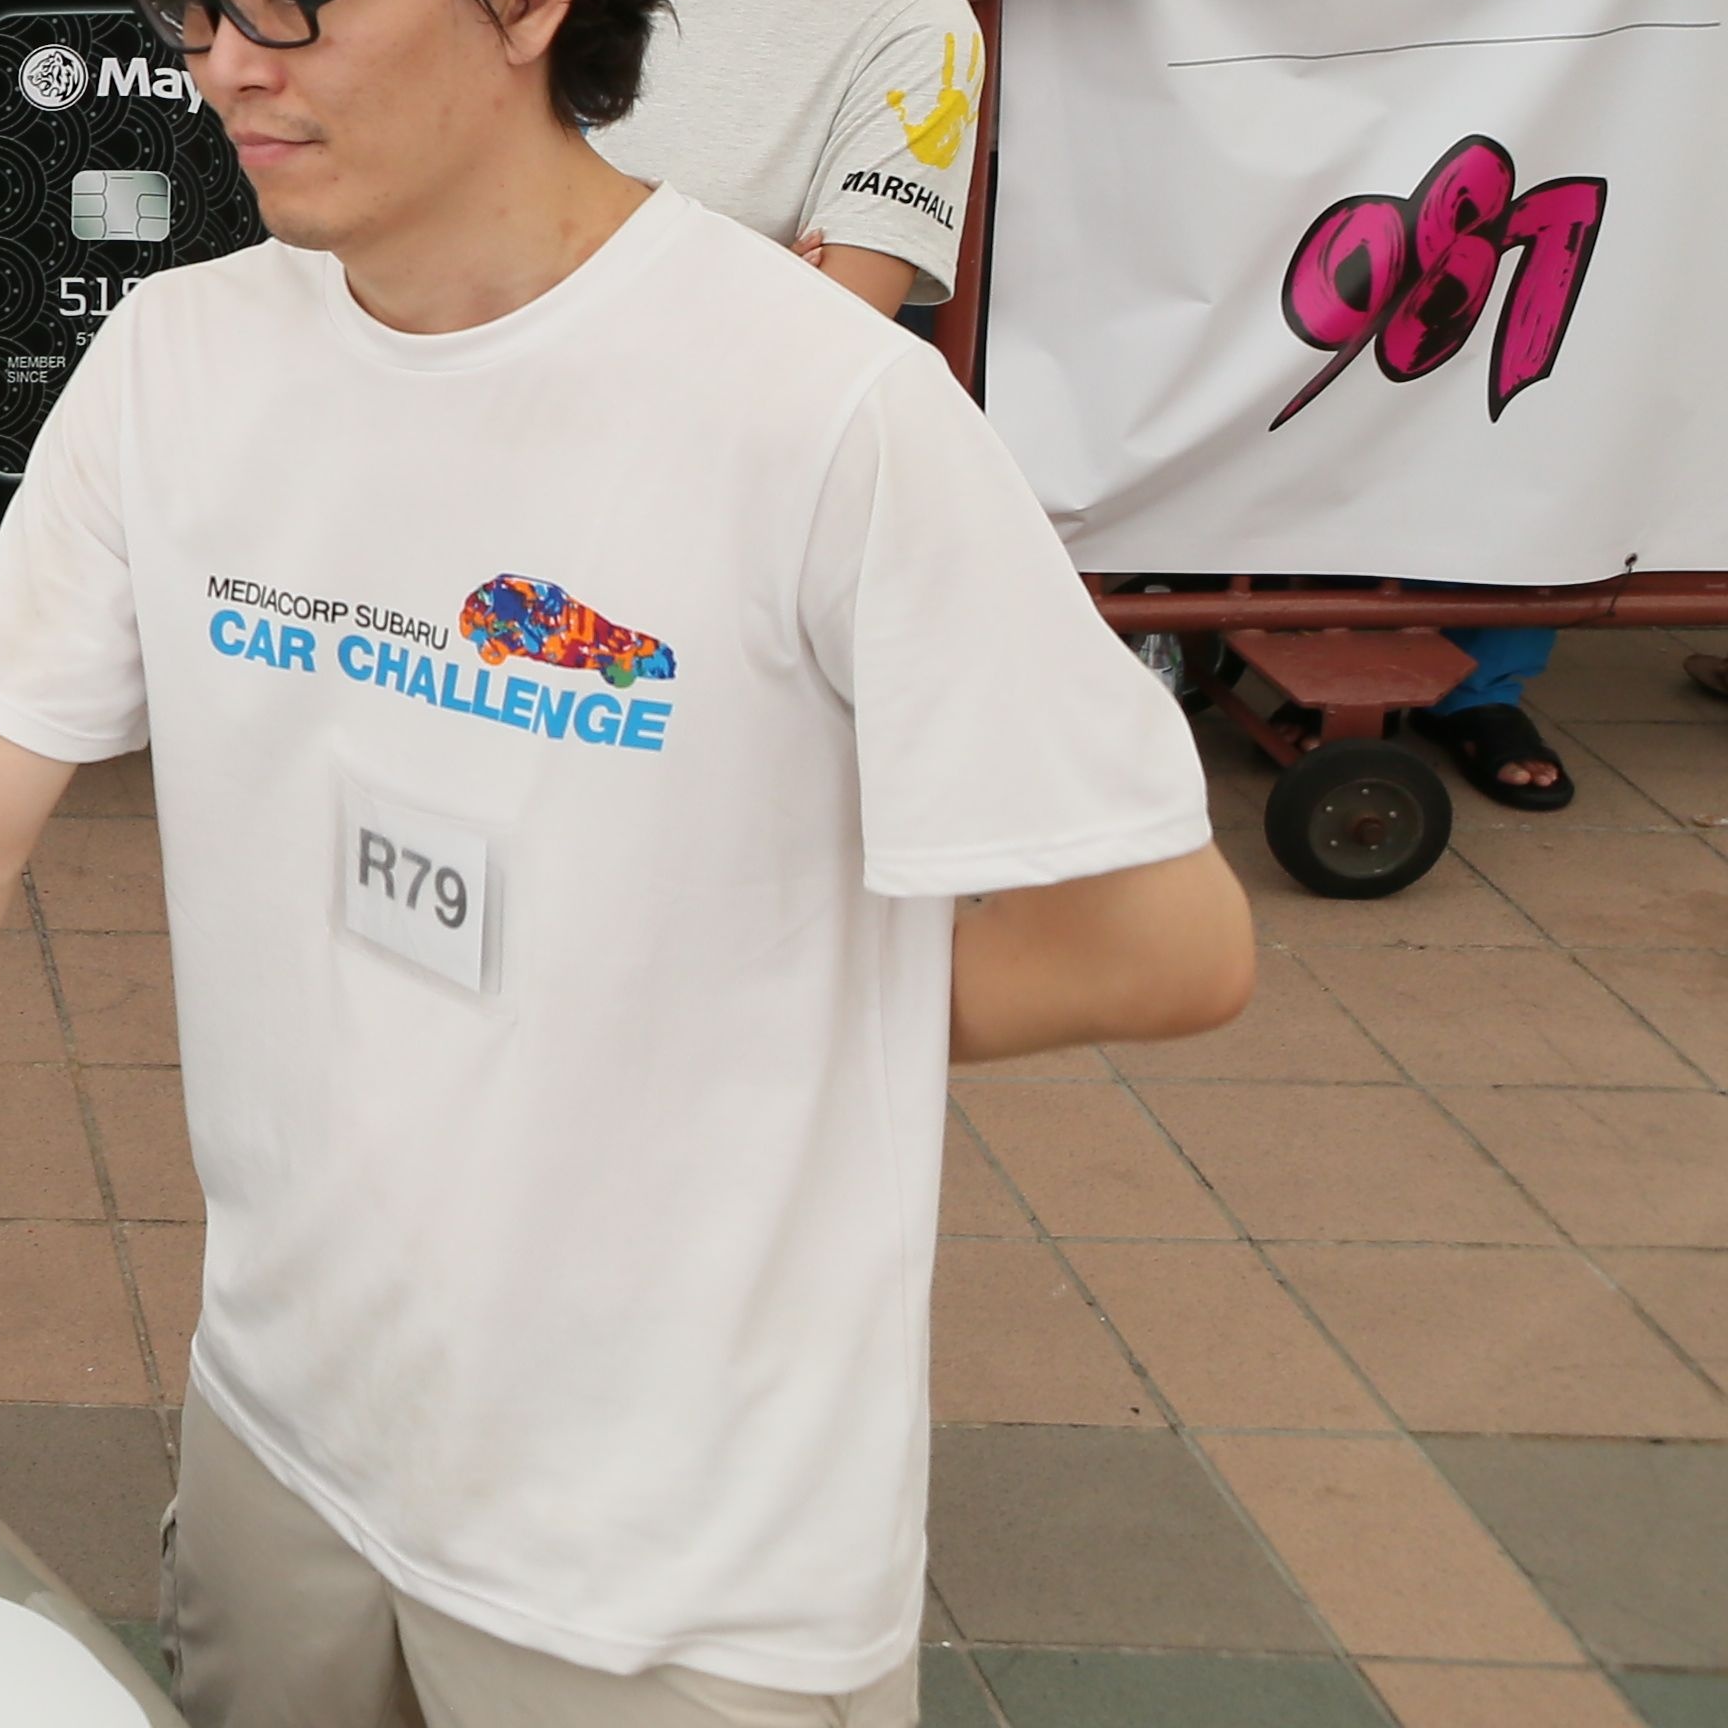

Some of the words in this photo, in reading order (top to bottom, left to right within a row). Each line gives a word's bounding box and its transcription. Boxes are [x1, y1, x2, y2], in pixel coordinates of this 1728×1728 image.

[1268, 133, 1609, 433] 987
[6, 370, 49, 384] SINCE
[7, 355, 67, 369] MEMBER
[206, 575, 349, 624] MEDIACORP
[354, 604, 449, 651] SUBARU
[208, 608, 318, 673] CAR
[336, 634, 674, 753] CHALLENGE
[357, 826, 468, 930] R79
